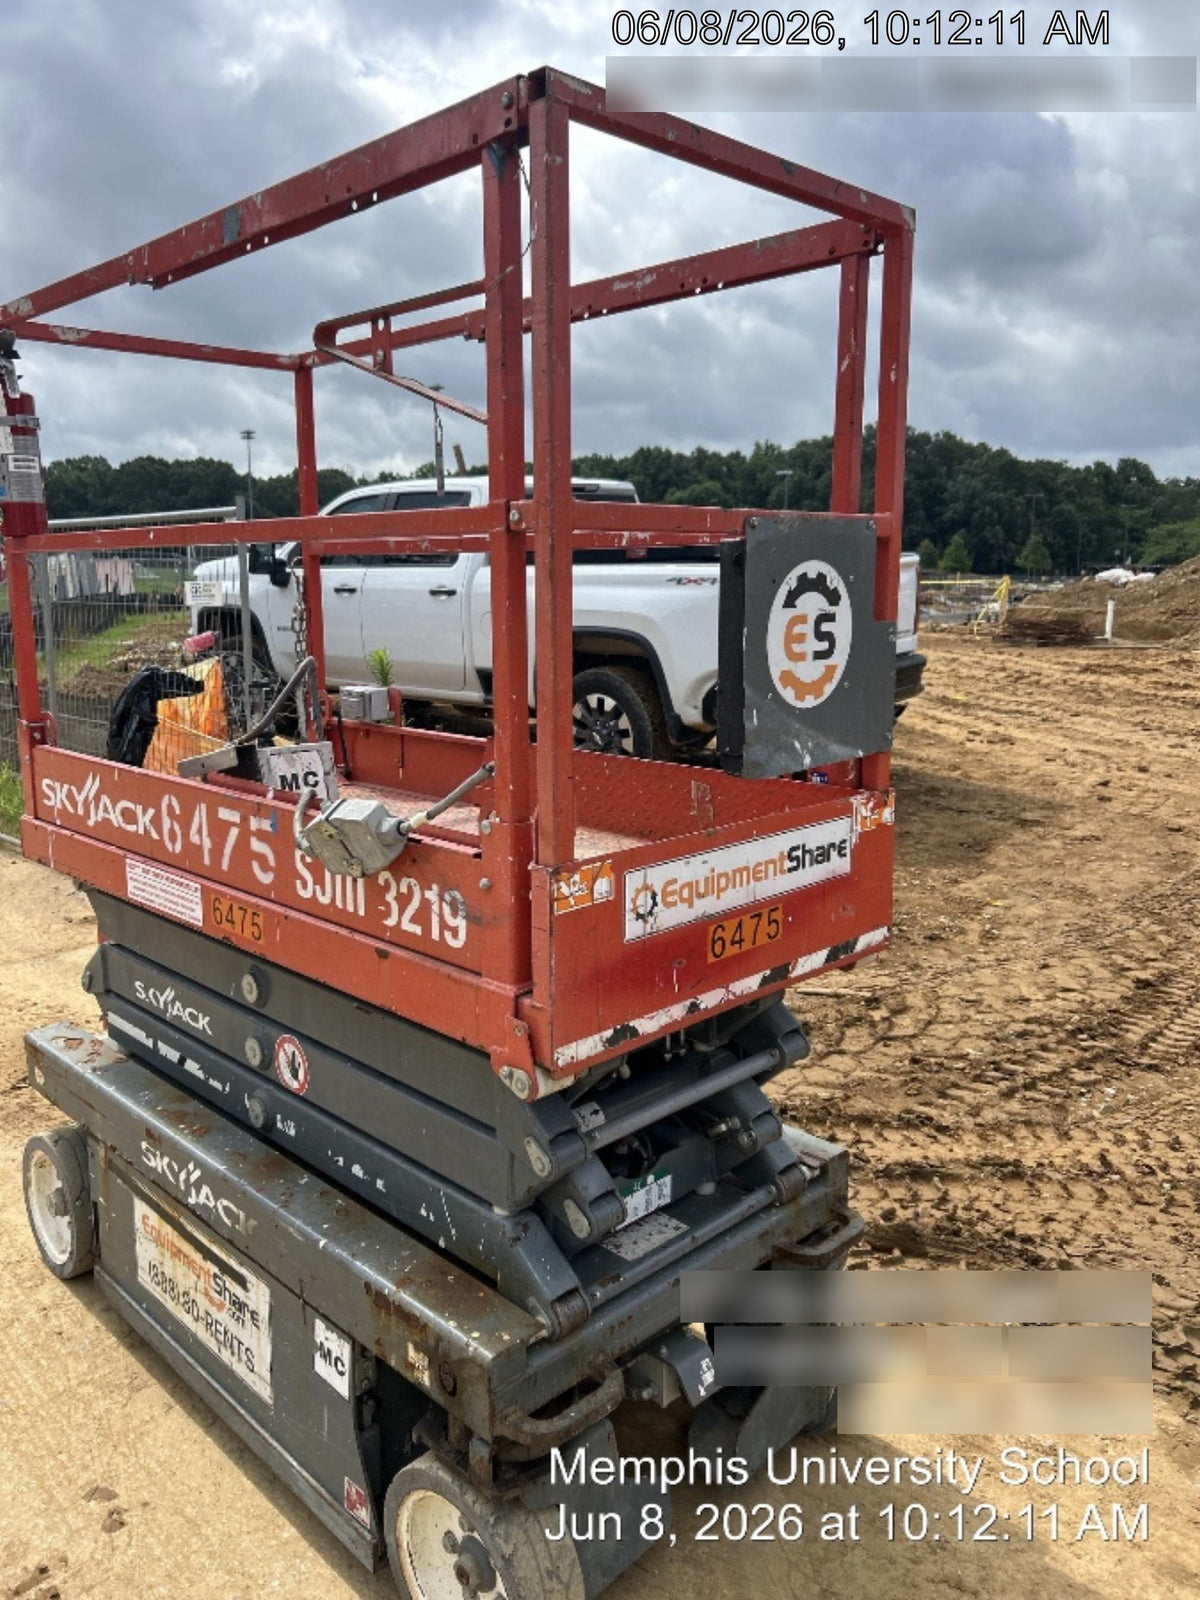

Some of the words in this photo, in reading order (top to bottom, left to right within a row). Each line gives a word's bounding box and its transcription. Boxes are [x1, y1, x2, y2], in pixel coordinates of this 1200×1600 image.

[783, 612, 836, 662] ES
[42, 771, 160, 840] SKYJACK
[279, 771, 319, 791] MC
[160, 794, 276, 884] 6475
[661, 838, 848, 910] EquipmentShare
[212, 897, 262, 941] 6475
[377, 870, 467, 948] 3219
[710, 906, 781, 959] 6475
[317, 1341, 347, 1378] MC
